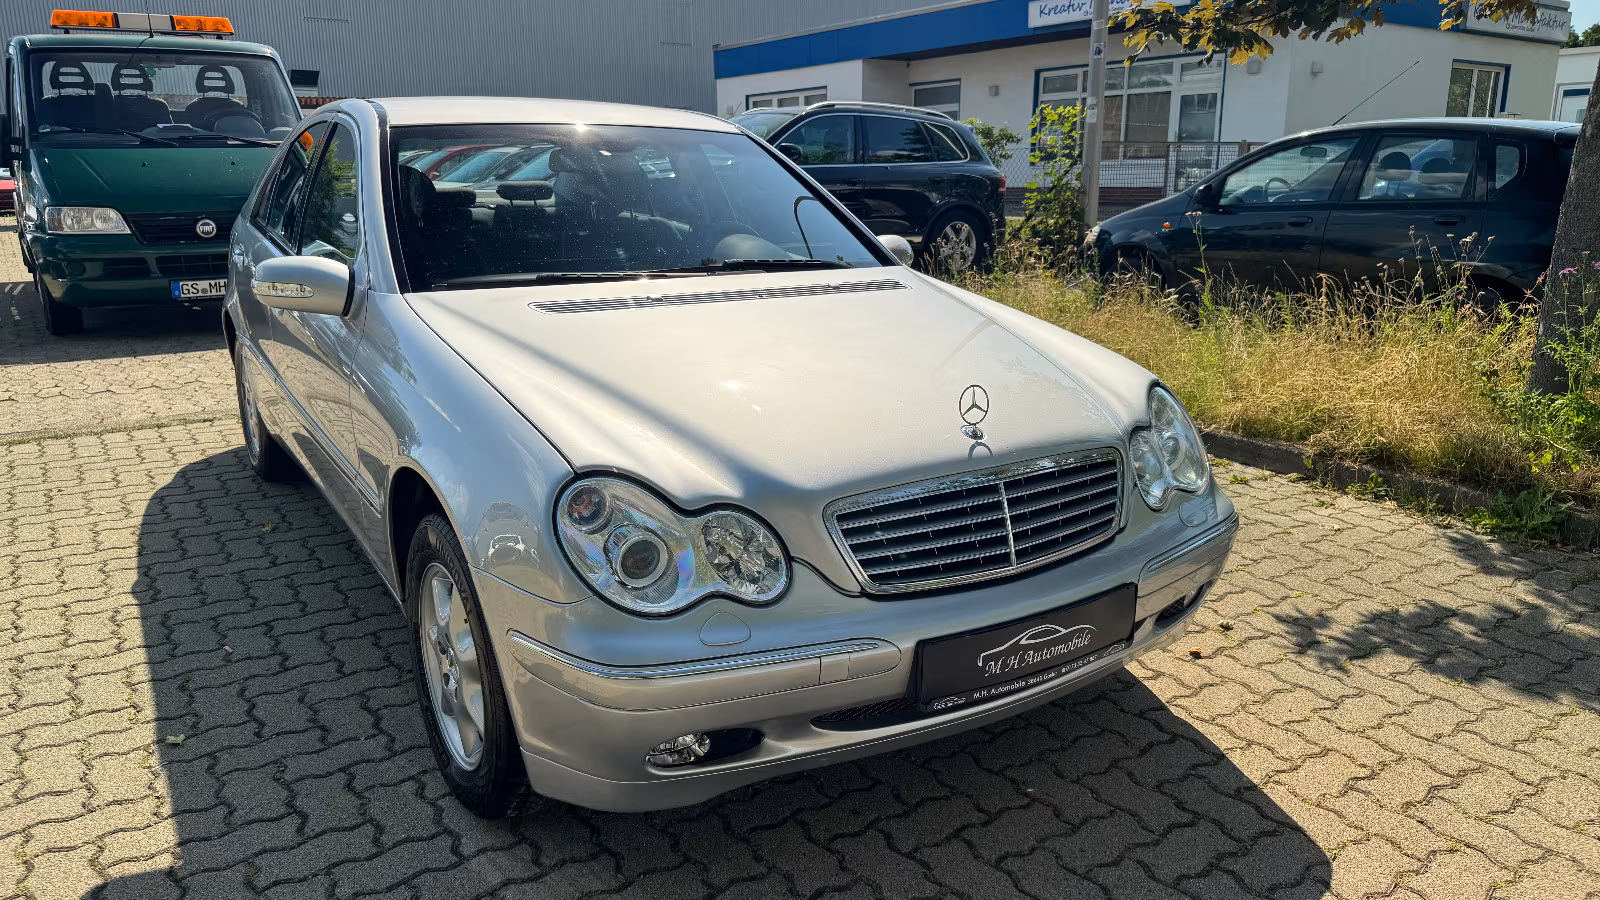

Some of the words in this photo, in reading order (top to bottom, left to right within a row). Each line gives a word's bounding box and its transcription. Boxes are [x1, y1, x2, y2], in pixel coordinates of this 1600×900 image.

[1039, 0, 1084, 18] Kreativ
[200, 225, 214, 233] FIAT
[181, 282, 200, 295] GS
[208, 281, 227, 294] MH
[985, 656, 1005, 677] M
[1005, 651, 1023, 671] H
[1022, 629, 1091, 667] Automobile
[973, 690, 989, 699] M.H.
[990, 681, 1026, 695] Automobile
